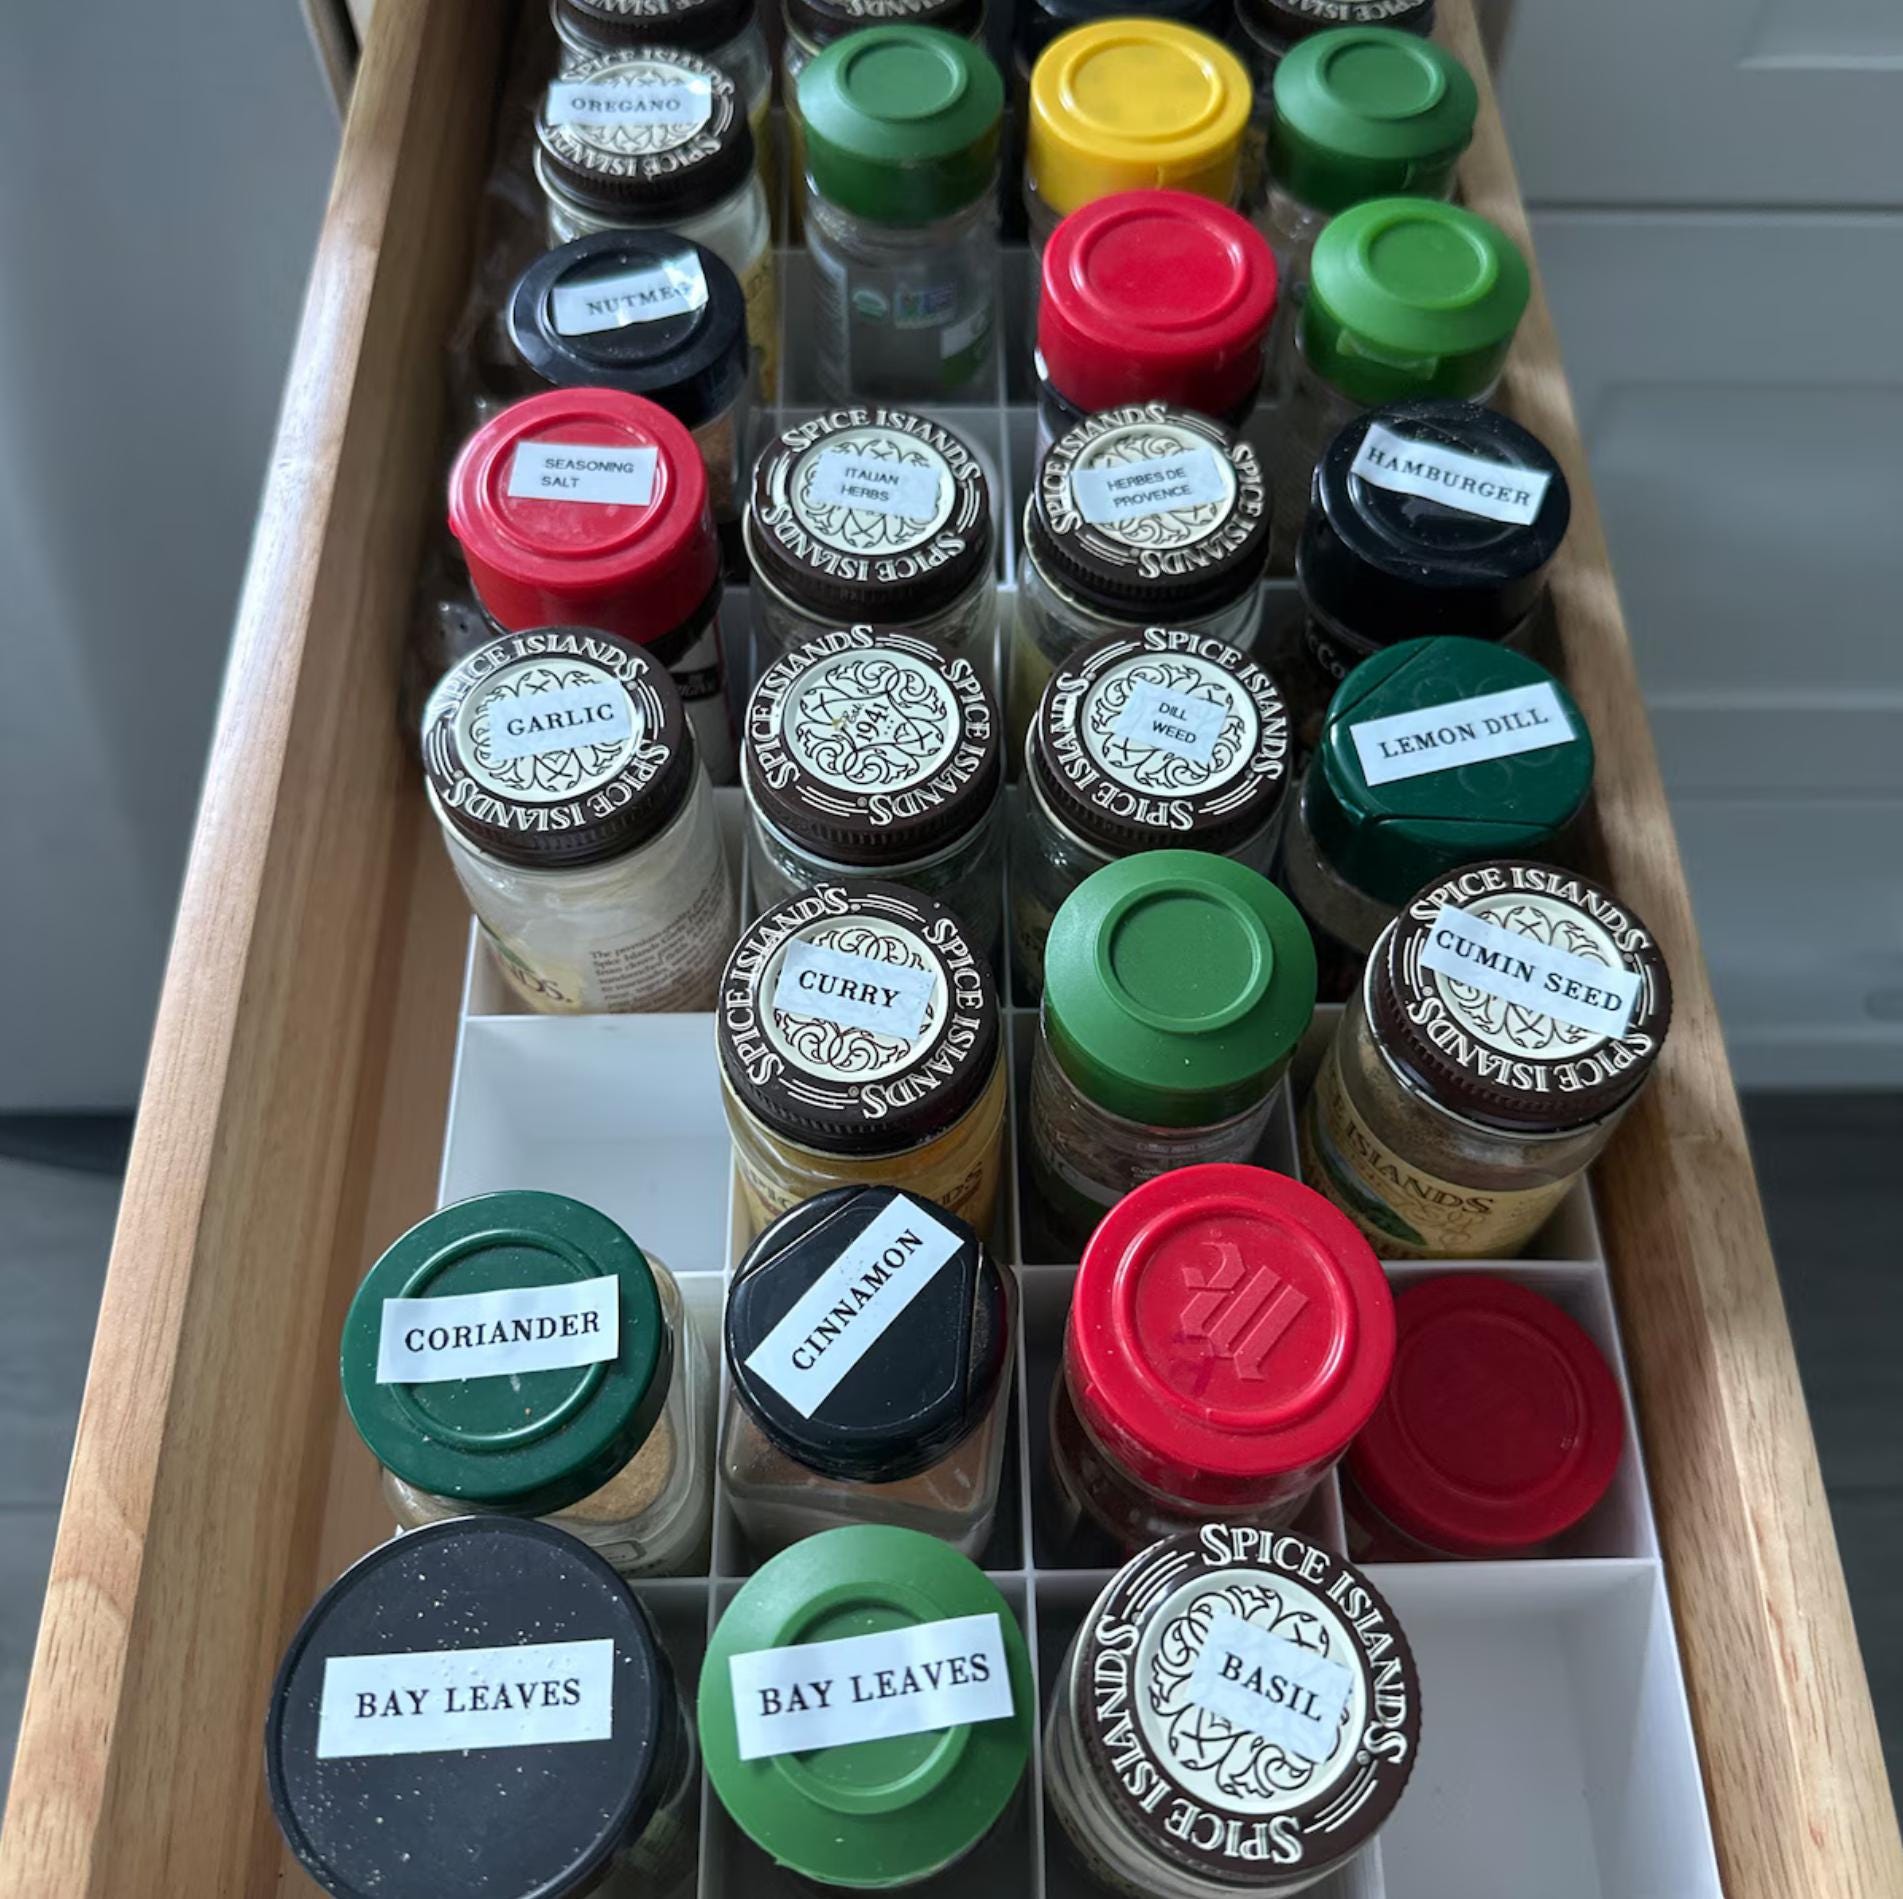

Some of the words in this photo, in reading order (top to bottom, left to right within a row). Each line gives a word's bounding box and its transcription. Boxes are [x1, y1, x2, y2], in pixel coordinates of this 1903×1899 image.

[571, 97, 682, 113] OREGANO
[642, 137, 722, 178] SPICE
[781, 409, 870, 453] SPICE
[876, 409, 981, 481] ISLANDS
[1054, 403, 1167, 461] ISLANDS
[540, 475, 580, 489] SALT
[544, 457, 635, 474] SEASONING
[840, 485, 890, 502] HERBS
[844, 466, 899, 486] ITALIAN
[1043, 460, 1083, 535] SPICE
[1107, 471, 1165, 492] HERBES
[1166, 467, 1187, 481] DE
[1113, 483, 1192, 508] PROVENCE
[1230, 443, 1264, 518] SPICE
[1366, 446, 1532, 507] HAMBURGER
[762, 503, 869, 581] ISLANDS
[876, 531, 966, 582] SPICE
[1138, 514, 1256, 579] ISLANDS
[513, 634, 649, 685] ISLANDS
[764, 625, 874, 700] ISLANDS
[507, 703, 615, 736] GARLIC
[856, 702, 889, 742] 1941
[940, 658, 991, 741] SPICE
[1050, 672, 1100, 791] ISLANDS
[1143, 627, 1242, 670] SPICE
[1240, 662, 1288, 780] ISLANDS
[1151, 720, 1197, 744] WEED
[1158, 702, 1187, 722] DILL
[751, 703, 801, 789] SPICE
[1377, 722, 1477, 759] LEMON
[1483, 708, 1549, 735] DILL
[445, 777, 586, 832] ISLANDS
[587, 739, 671, 818] SPICE
[869, 742, 986, 826] ISLANDS
[1092, 782, 1194, 831] SPICE
[730, 885, 849, 986] ISLANDS
[1409, 866, 1507, 929] SPICE
[1511, 866, 1650, 957] ISLANDS
[798, 969, 902, 1009] CURRY
[923, 917, 984, 1011] SPICE
[1434, 929, 1537, 984] CUMIN
[1542, 971, 1623, 1012] SEED
[726, 988, 785, 1086] SPICE
[860, 1014, 982, 1119] ISLANDS
[1407, 998, 1551, 1093] ISLANDS
[1347, 1119, 1494, 1215] ISLANDS
[404, 1310, 601, 1352] CORIANDER
[791, 1228, 924, 1371] CINNAMON
[1200, 1523, 1331, 1584] SPICE
[1326, 1571, 1407, 1764] ISLANDS
[355, 1688, 430, 1718] BAY
[445, 1678, 581, 1713] LEAVES
[758, 1680, 833, 1716] BAY
[850, 1653, 990, 1703] LEAVES
[1095, 1615, 1173, 1814] ISLANDS
[1217, 1651, 1325, 1723] BASIL
[1164, 1799, 1303, 1865] SPICE
